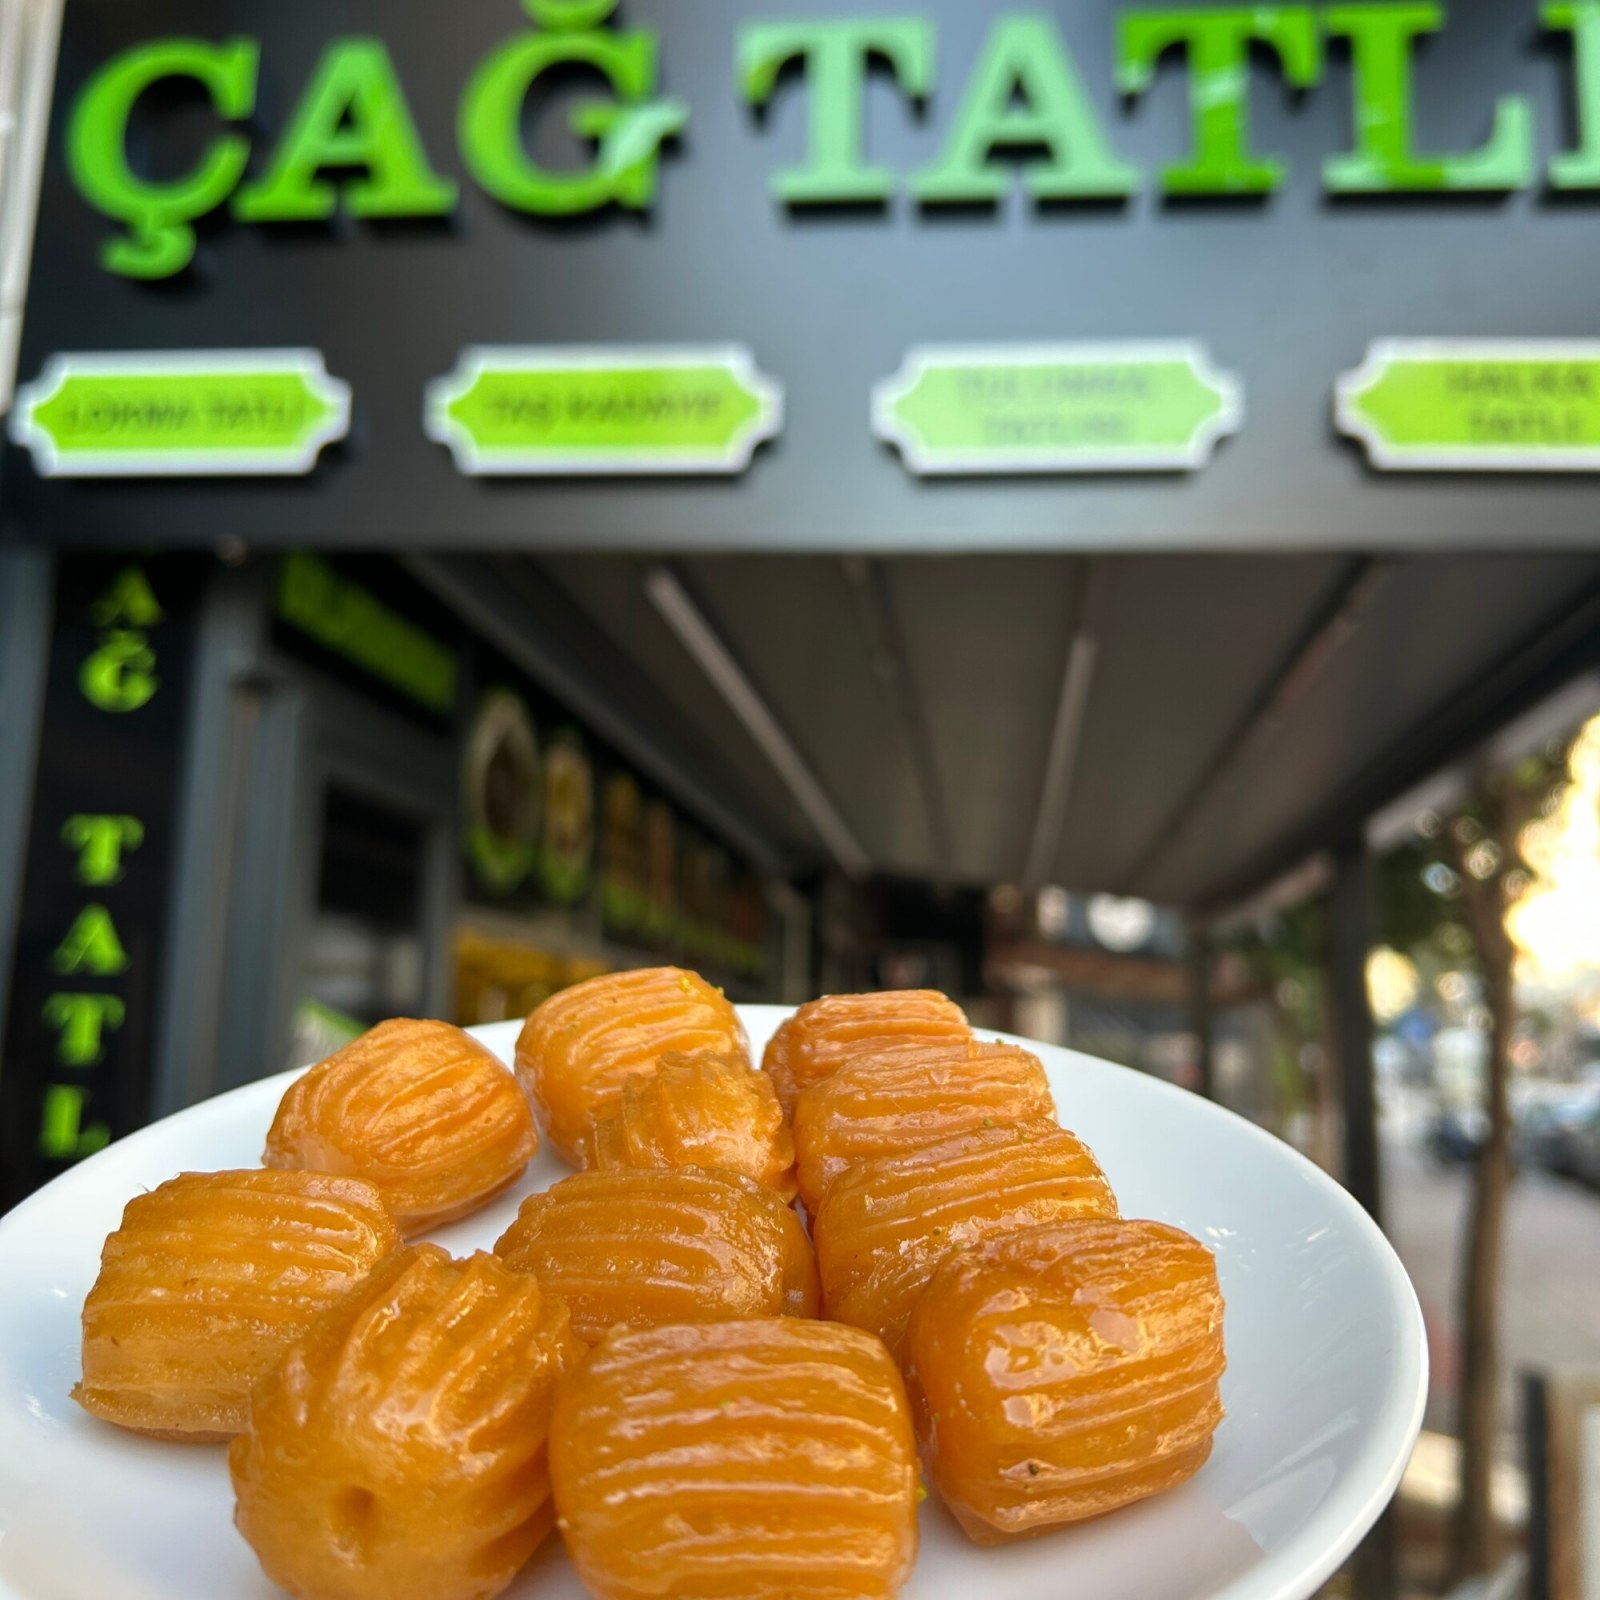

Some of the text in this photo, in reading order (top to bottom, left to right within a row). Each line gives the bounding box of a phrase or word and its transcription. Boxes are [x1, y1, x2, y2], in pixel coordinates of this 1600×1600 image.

[65, 0, 690, 280] ÇAĞ
[80, 565, 162, 713] AĞ
[40, 813, 145, 1158] TATL
